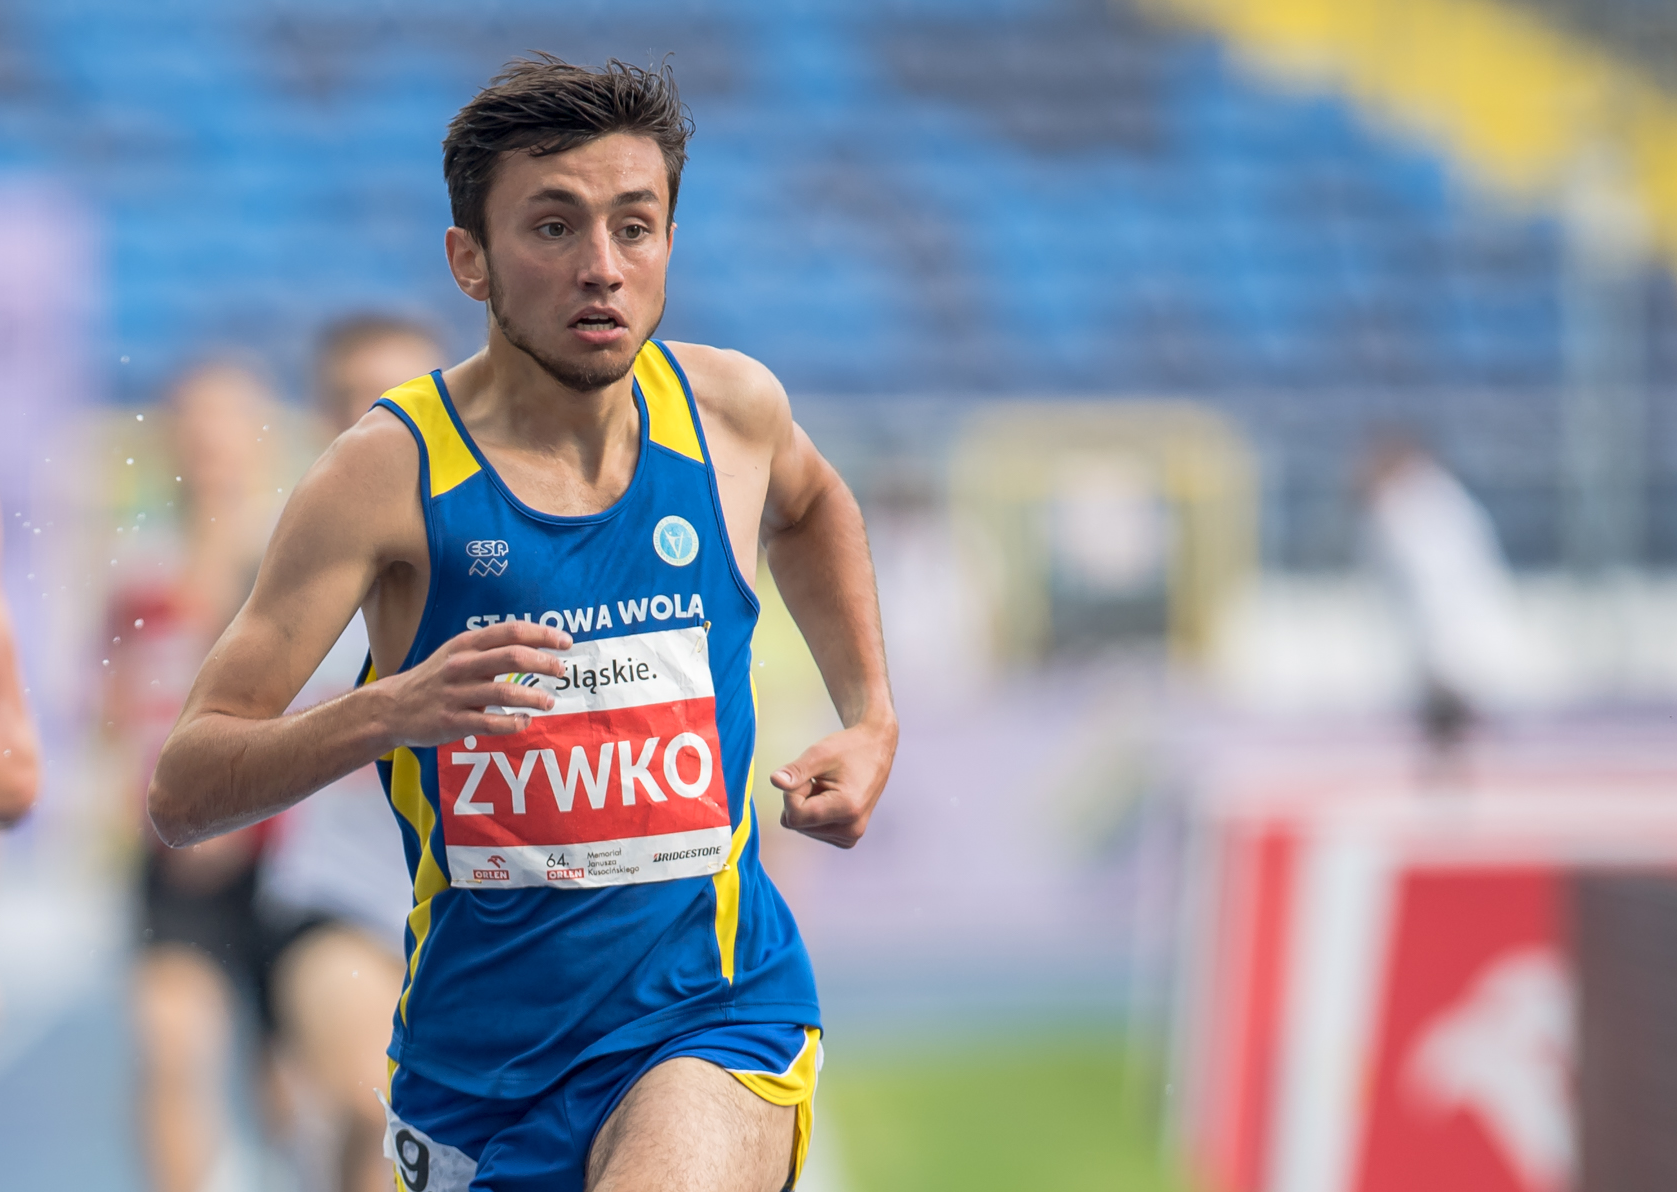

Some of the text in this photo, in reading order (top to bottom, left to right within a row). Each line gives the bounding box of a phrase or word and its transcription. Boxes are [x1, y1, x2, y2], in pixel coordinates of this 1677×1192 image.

[618, 593, 705, 625] WOLA
[452, 732, 713, 815] ŻYWKO
[546, 848, 622, 867] 64. Memoriał
[652, 846, 721, 862] BRIDGESTONE
[587, 860, 617, 868] Janusza
[588, 865, 640, 876] Kusocińskiego
[475, 870, 508, 879] ORLEN
[548, 869, 583, 879] ORLEN
